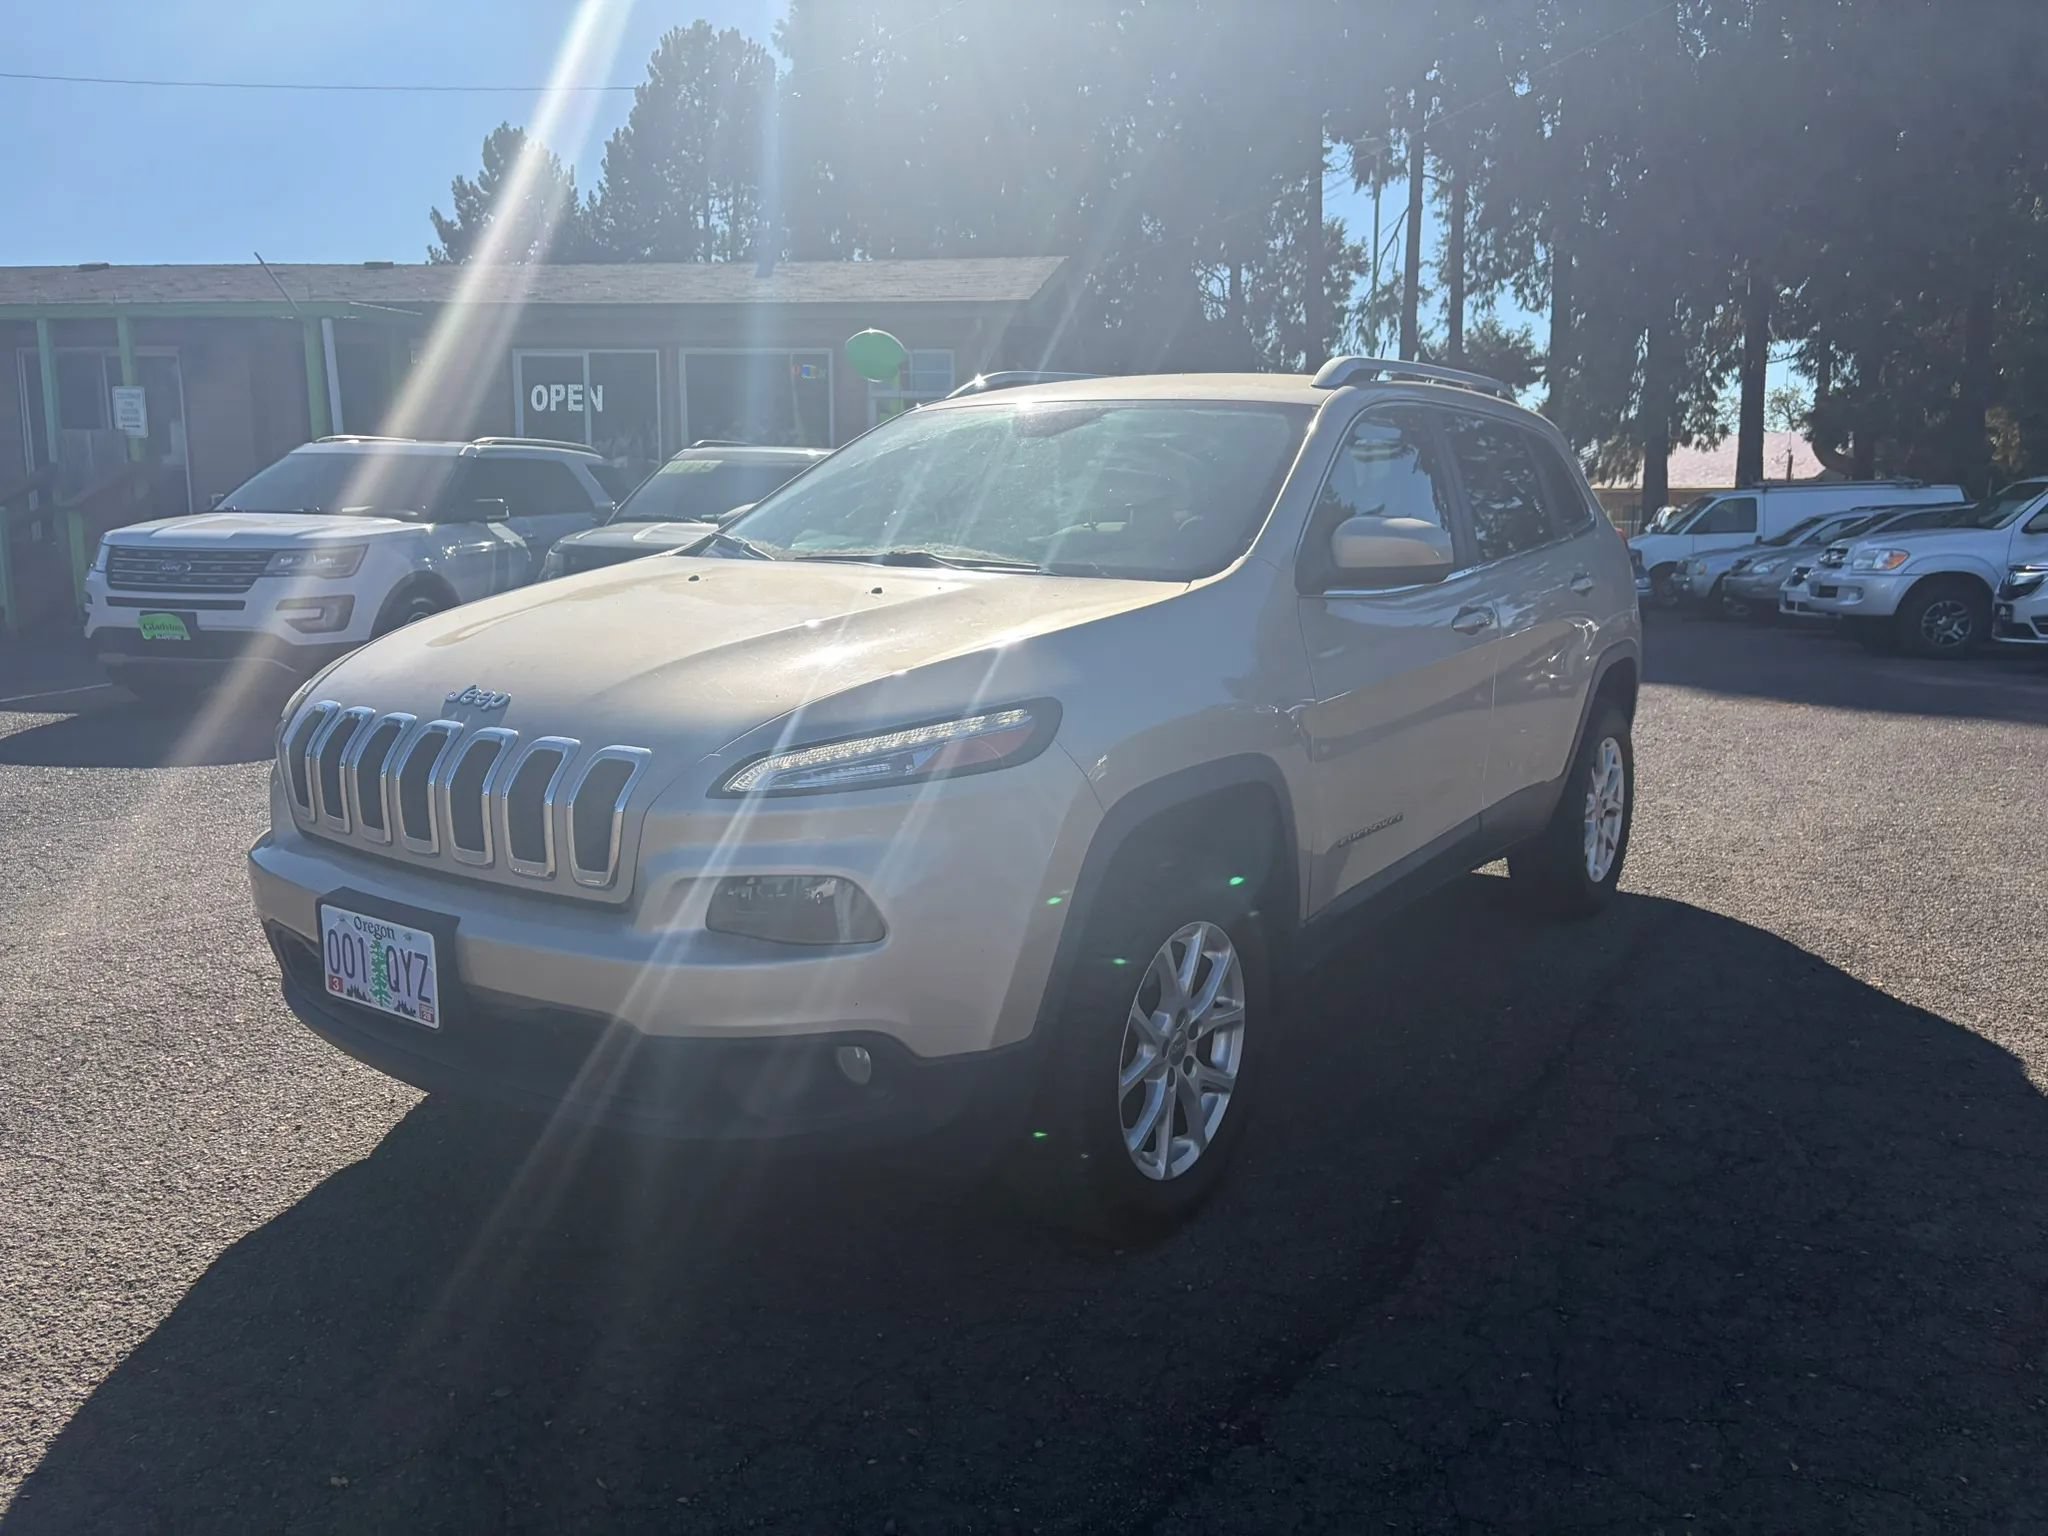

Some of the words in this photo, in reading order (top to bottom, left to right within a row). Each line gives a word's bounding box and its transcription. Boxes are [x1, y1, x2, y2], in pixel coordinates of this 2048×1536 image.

[530, 383, 604, 412] OPEN
[446, 684, 512, 712] Jeep
[353, 915, 396, 941] Oregon
[327, 928, 367, 984] 001
[385, 944, 432, 1004] QYZ
[331, 978, 340, 991] 3
